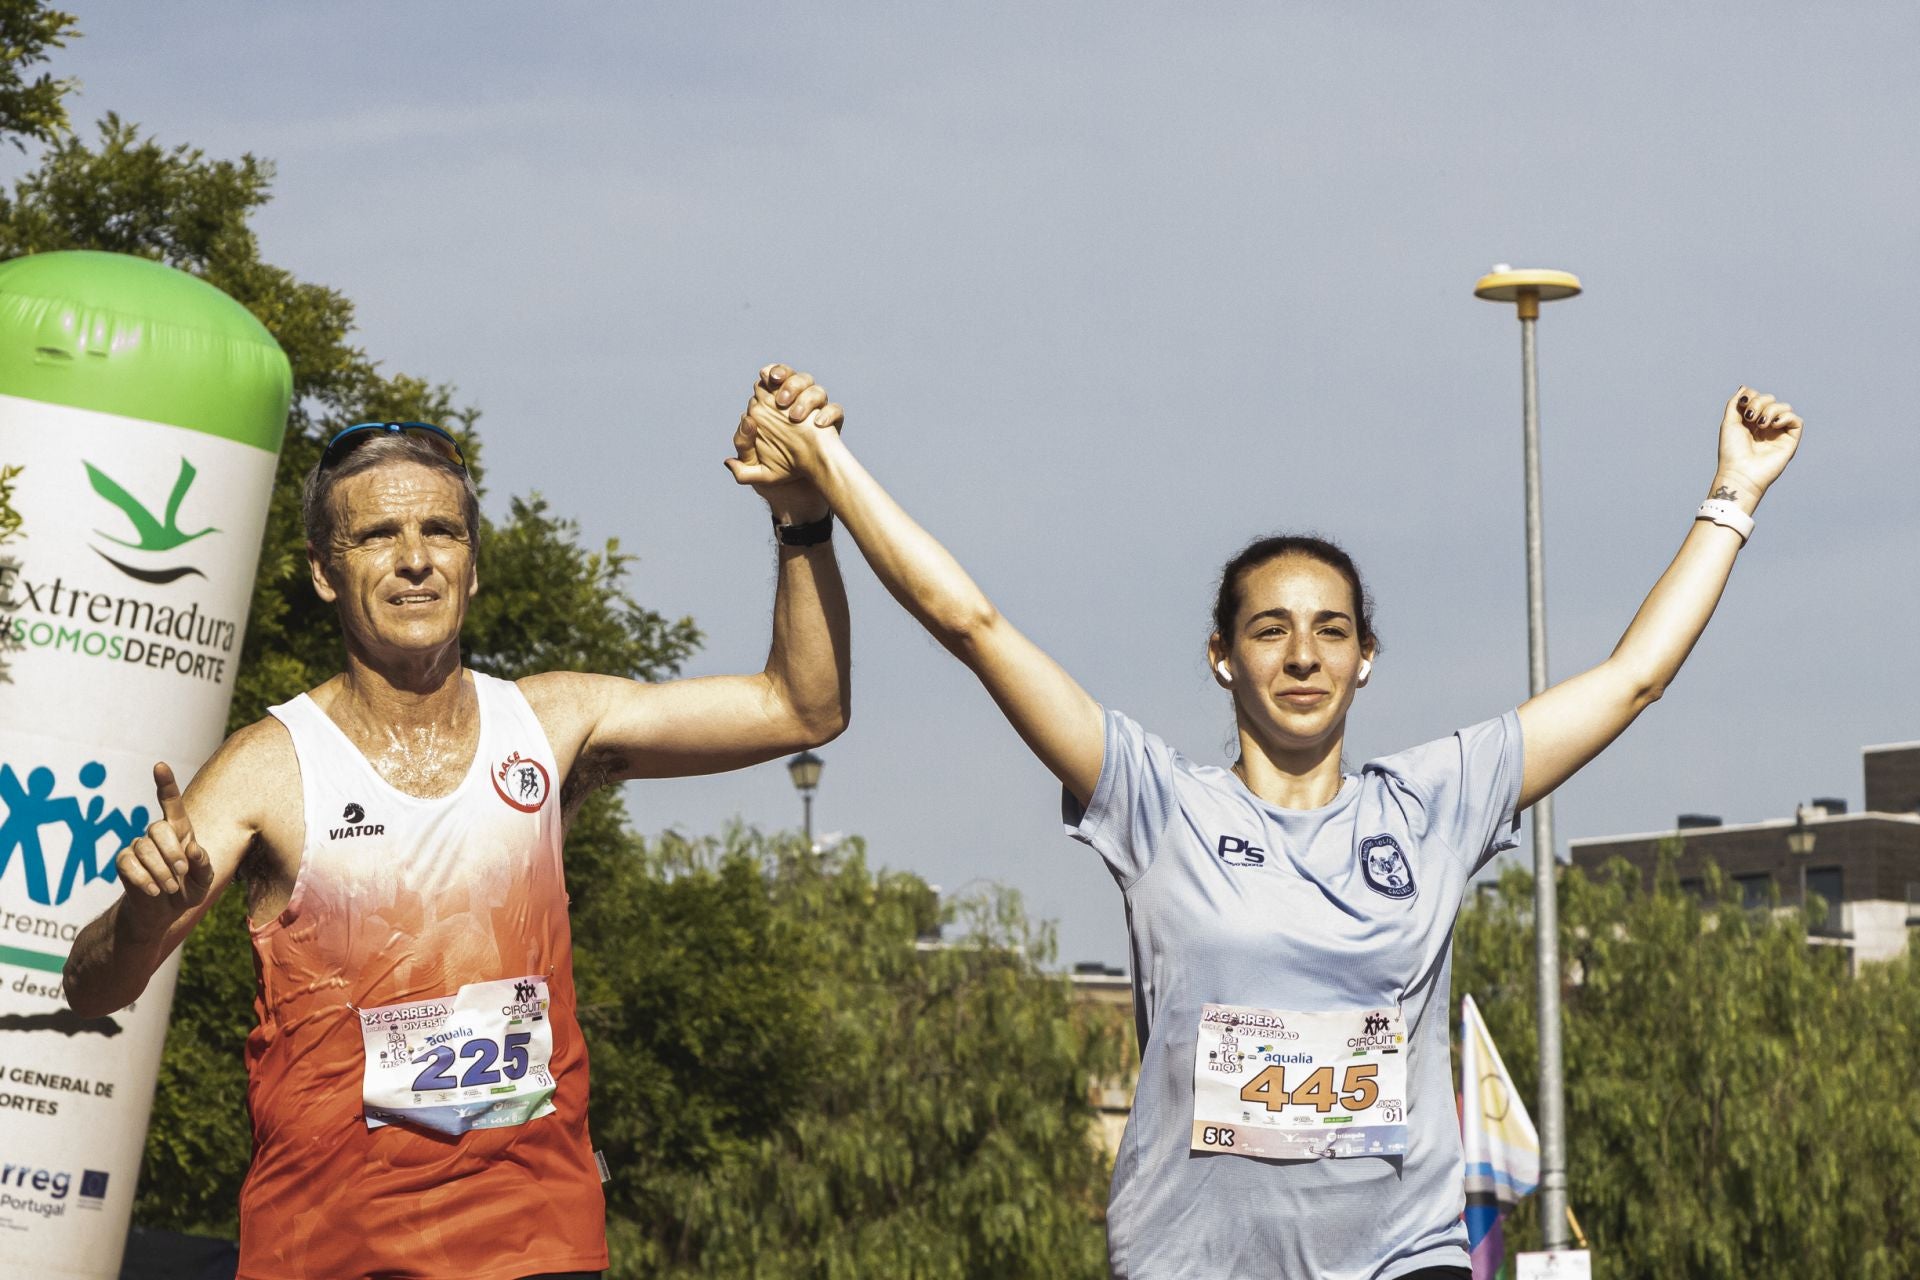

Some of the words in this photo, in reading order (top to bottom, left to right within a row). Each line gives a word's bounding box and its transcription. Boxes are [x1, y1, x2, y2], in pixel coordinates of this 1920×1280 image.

[329, 824, 385, 840] VIATOR
[0, 908, 79, 942] rema
[381, 1004, 448, 1021] CARRERA
[430, 1027, 473, 1046] aqualia
[1238, 1027, 1300, 1040] DIVERSIDAD
[411, 1032, 532, 1092] 225
[1264, 1052, 1313, 1066] aqualia
[10, 1068, 90, 1096] GENERAL
[94, 1082, 115, 1099] DE
[1240, 1063, 1380, 1113] 445
[1377, 1100, 1401, 1108] JUNIO
[1383, 1108, 1402, 1122] 01
[1, 1194, 67, 1218] Portugal
